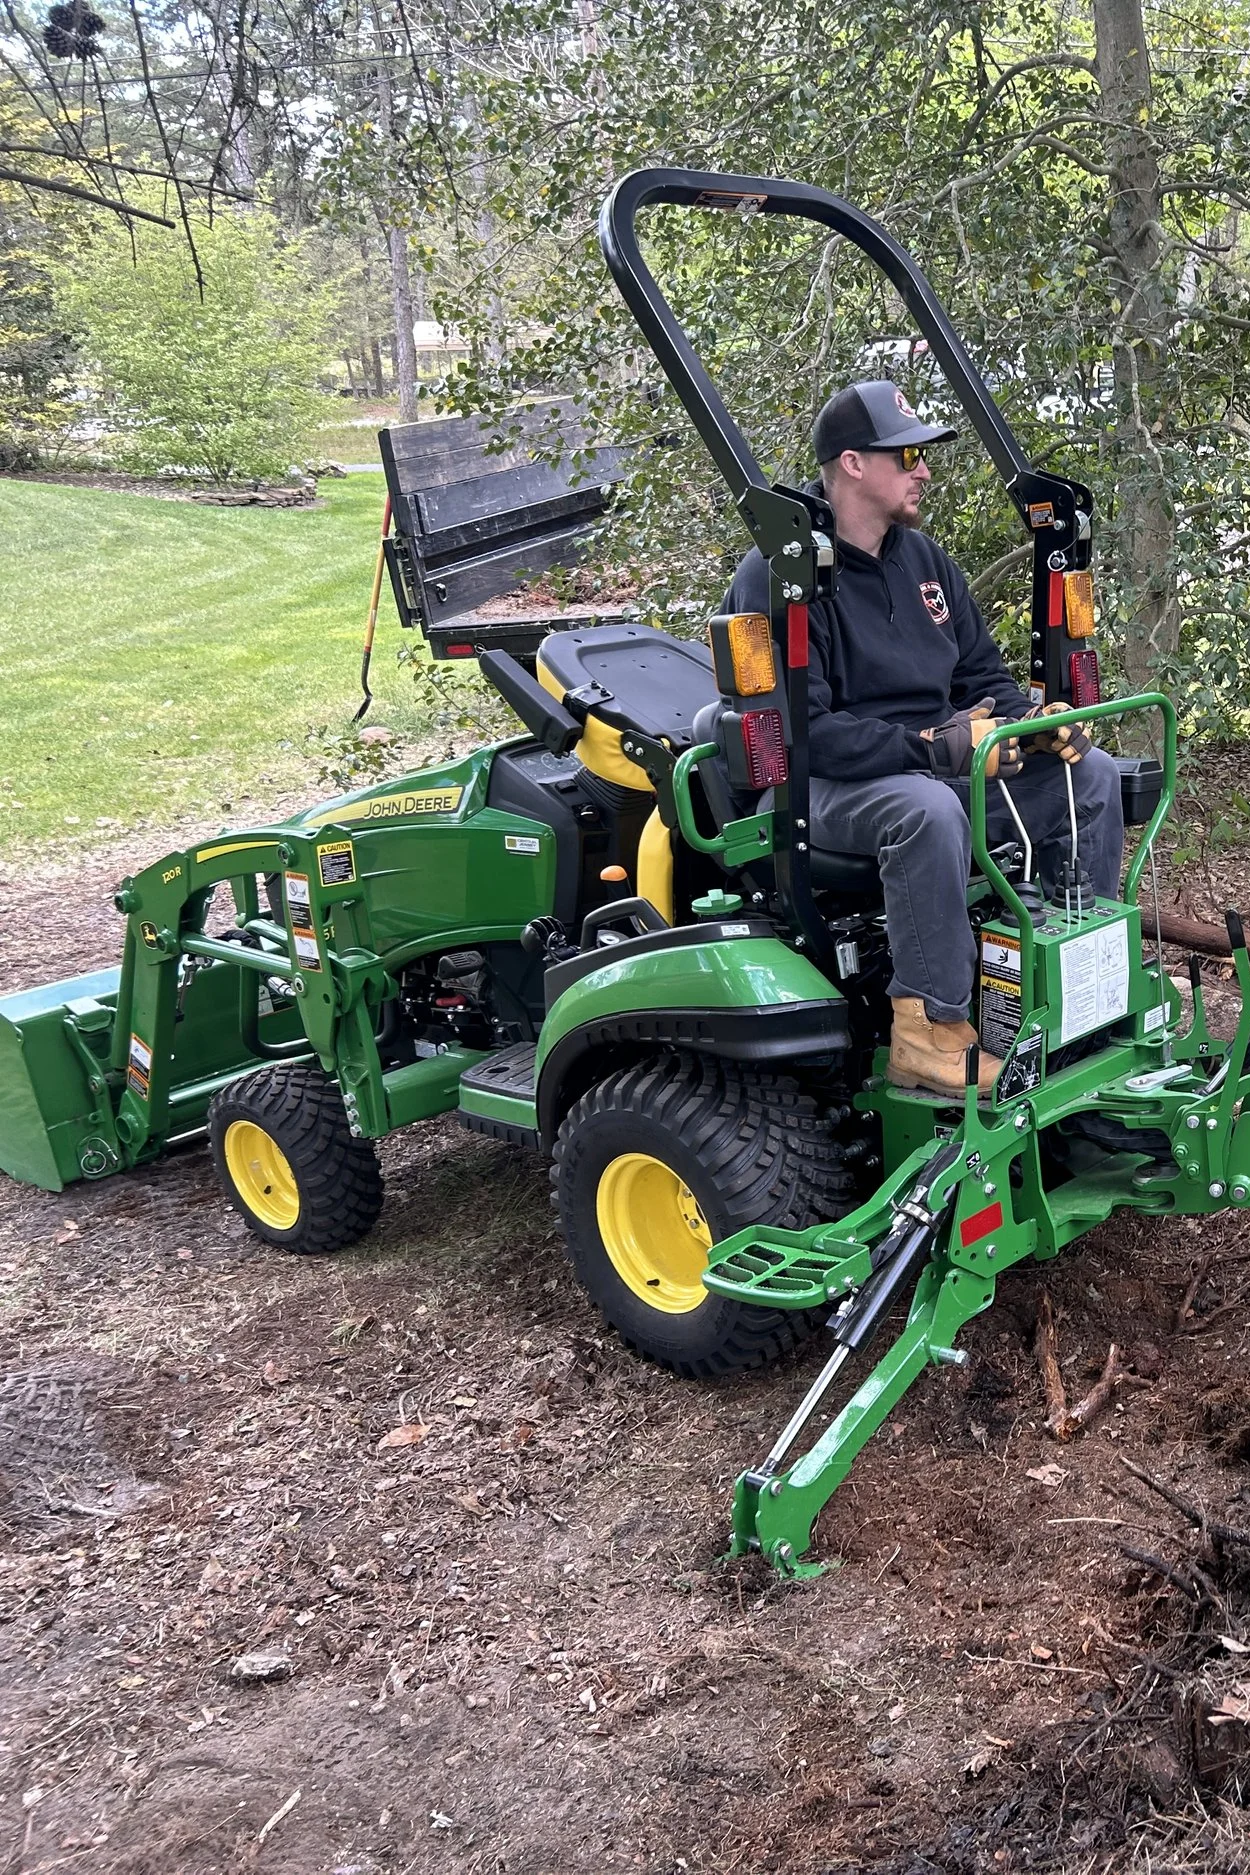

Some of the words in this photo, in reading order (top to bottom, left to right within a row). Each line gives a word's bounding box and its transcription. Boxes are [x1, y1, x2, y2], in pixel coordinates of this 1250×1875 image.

[363, 800, 401, 818] JOHN
[404, 796, 453, 812] DEERE
[327, 842, 350, 852] CAUTION
[162, 869, 175, 884] 120
[175, 866, 182, 877] R
[991, 936, 1021, 950] WARNING
[992, 981, 1020, 995] CAUTION
